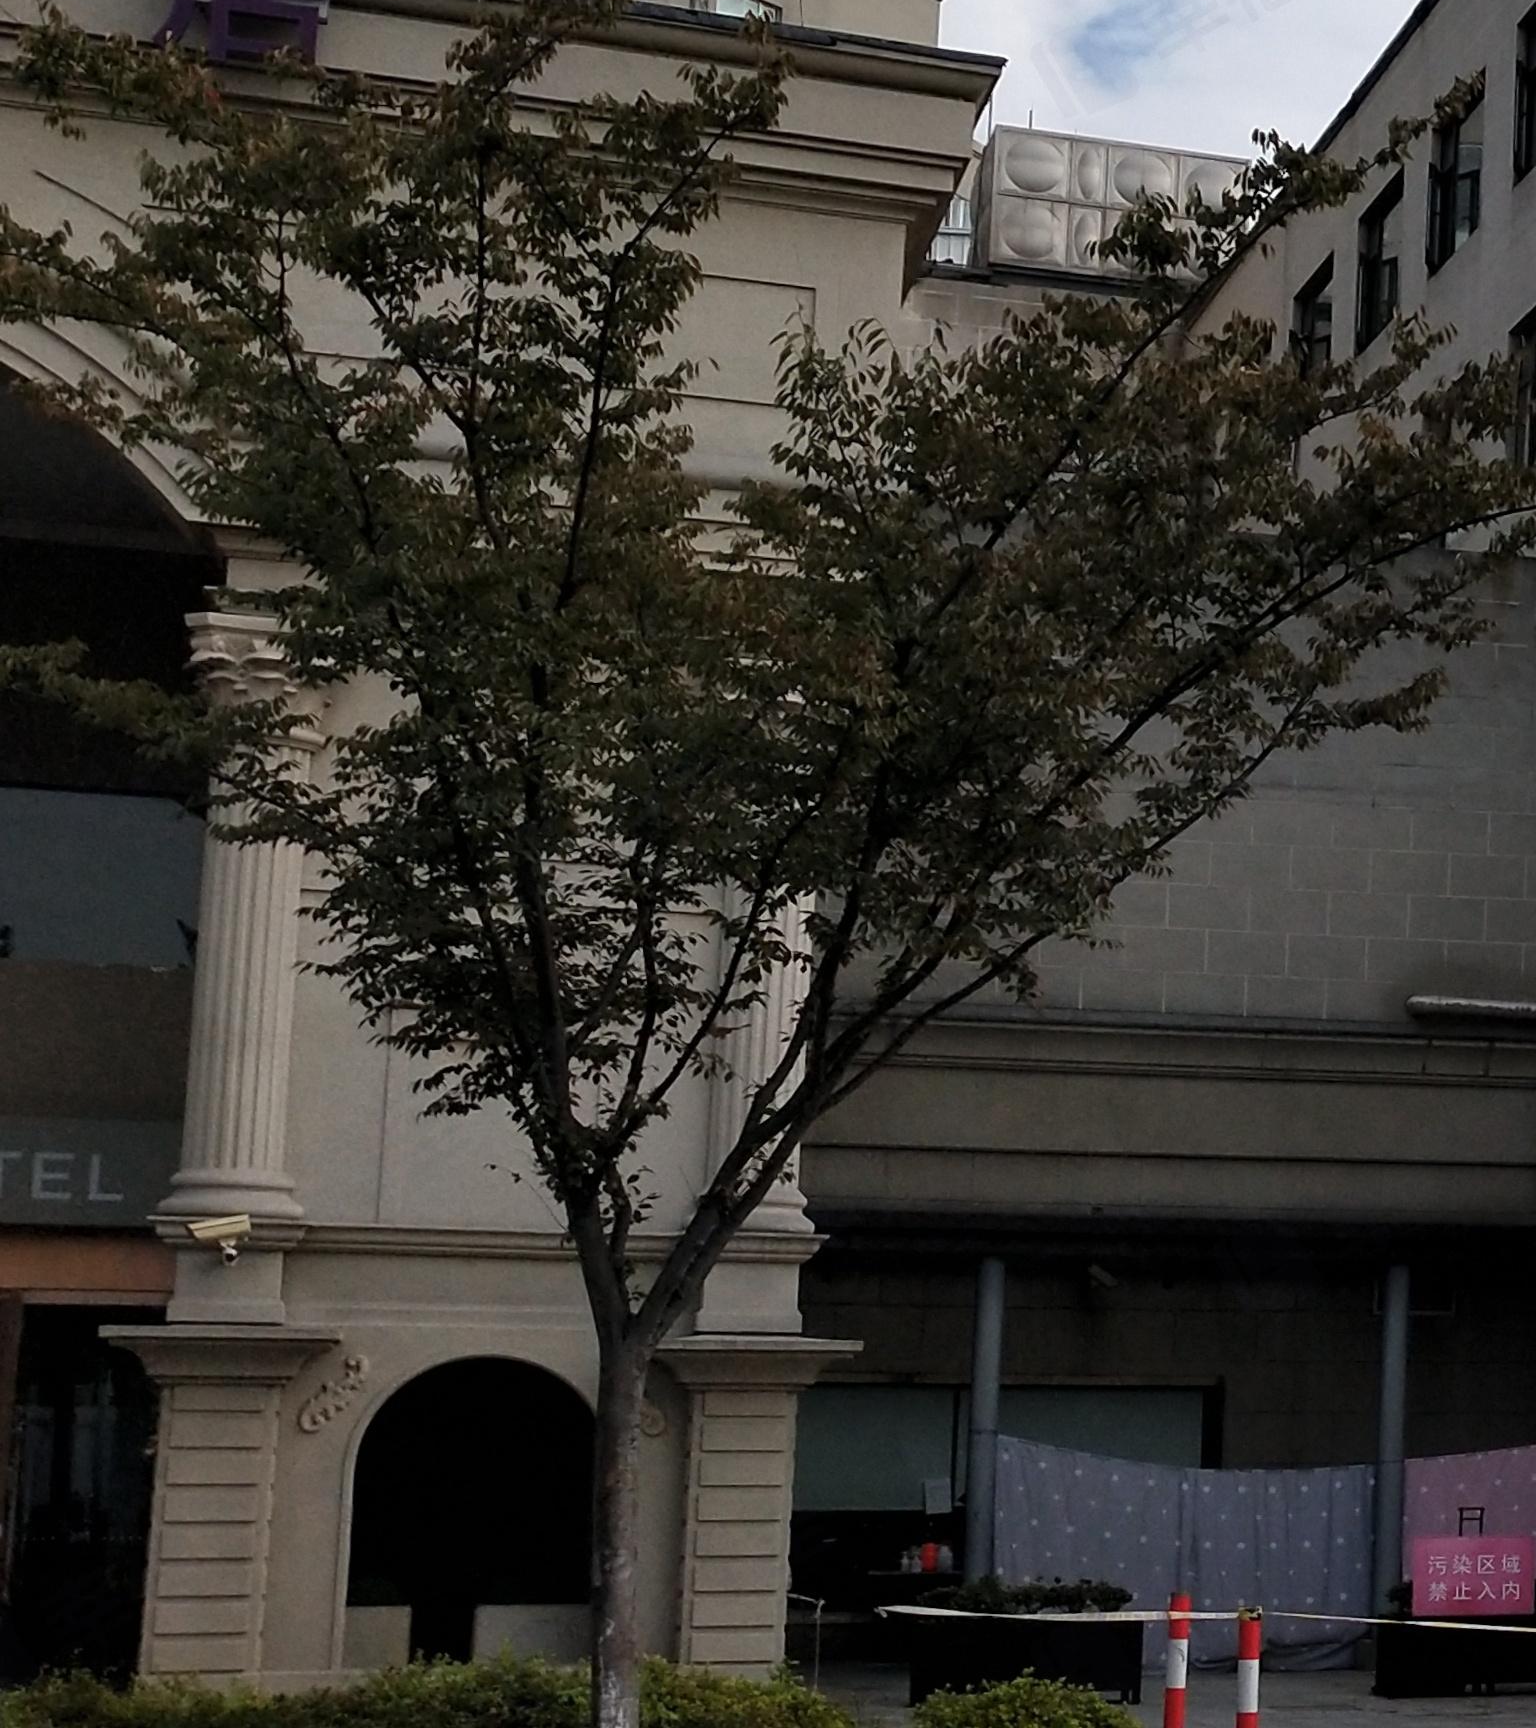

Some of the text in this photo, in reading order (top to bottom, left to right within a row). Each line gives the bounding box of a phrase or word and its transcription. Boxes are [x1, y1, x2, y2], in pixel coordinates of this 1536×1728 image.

[1427, 1553, 1522, 1576] 污染区域
[1427, 1580, 1522, 1603] 禁止入内
